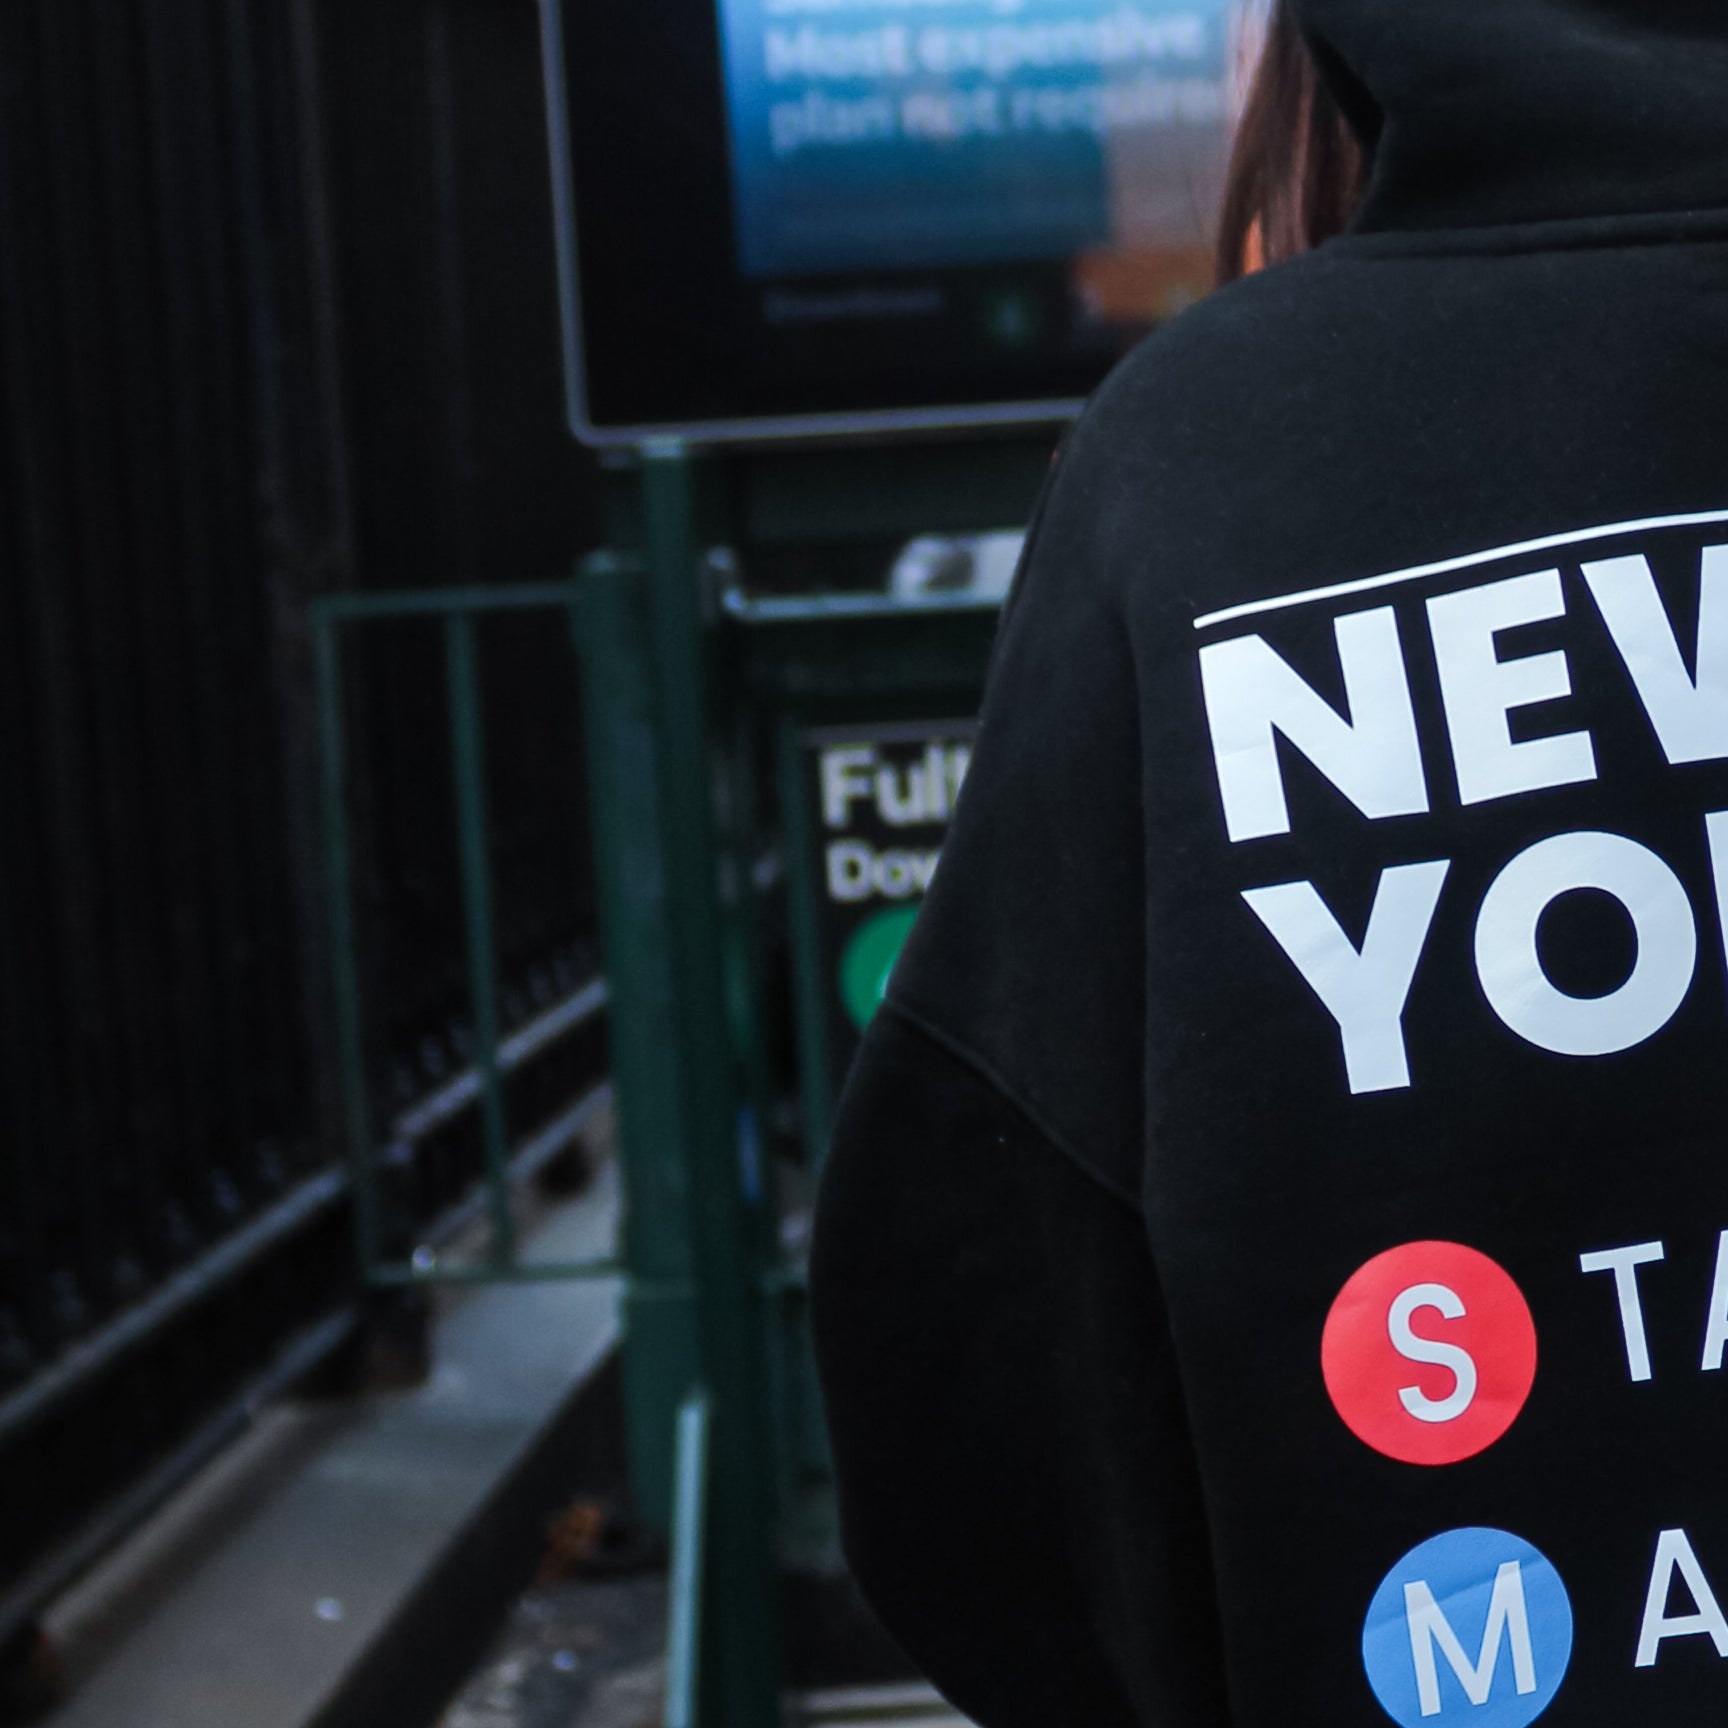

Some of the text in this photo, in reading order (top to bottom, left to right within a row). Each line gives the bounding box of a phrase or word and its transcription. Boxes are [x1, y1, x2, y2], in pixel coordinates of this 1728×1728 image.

[764, 24, 907, 80] Most
[1386, 1282, 1478, 1424] S
[1402, 1560, 1538, 1718] M
